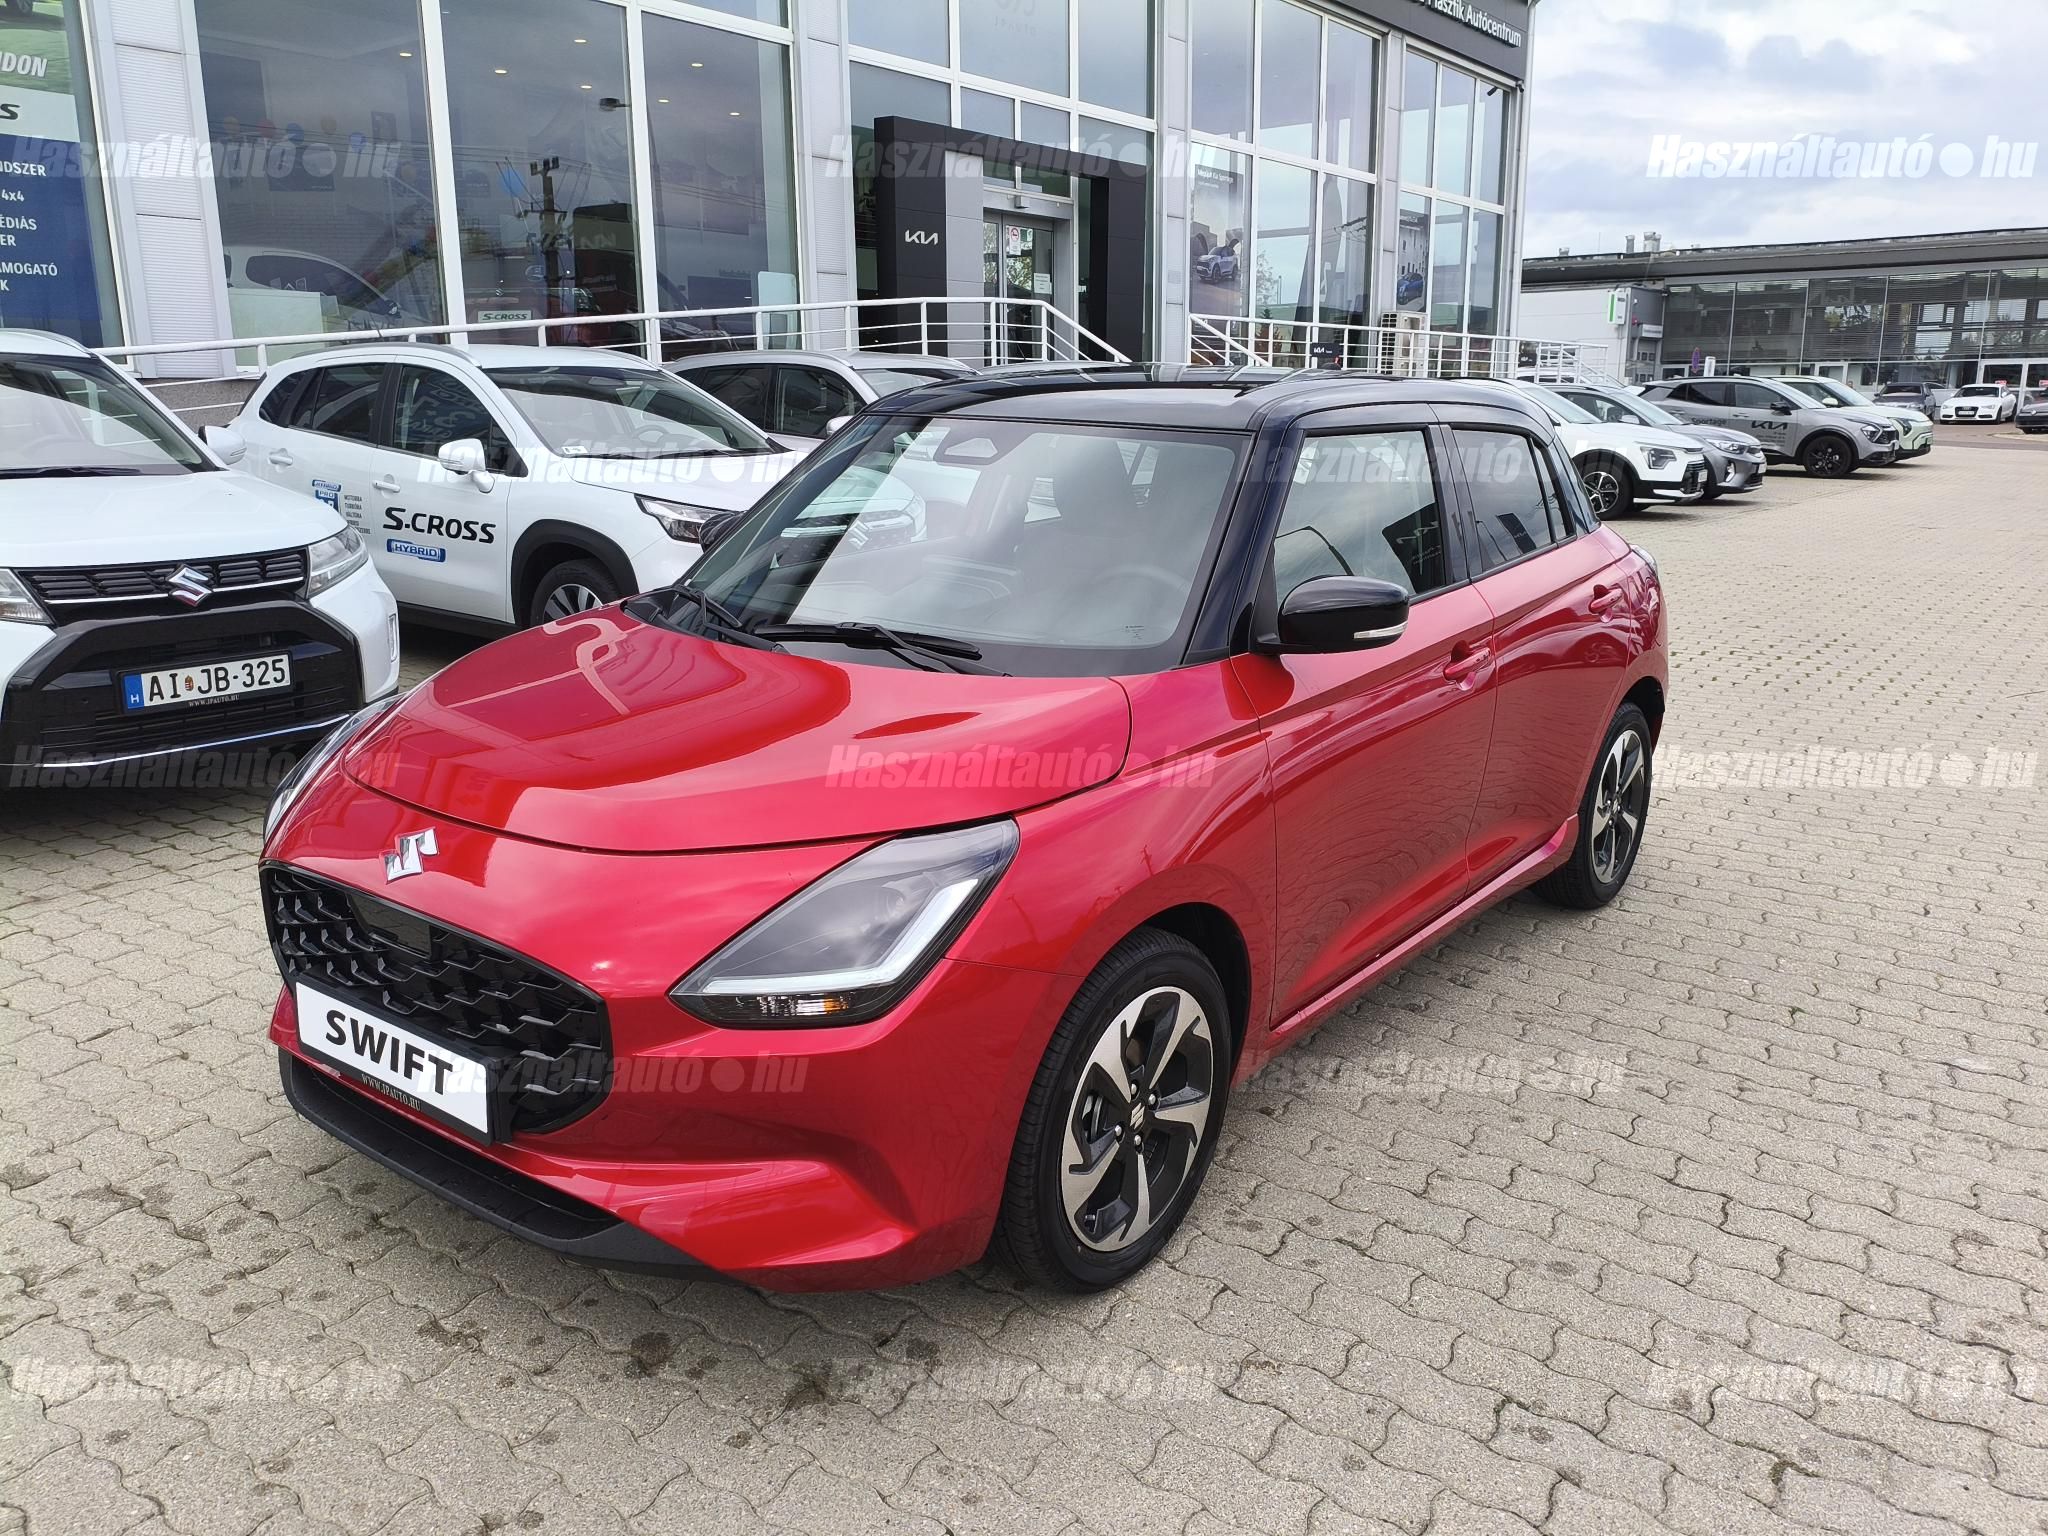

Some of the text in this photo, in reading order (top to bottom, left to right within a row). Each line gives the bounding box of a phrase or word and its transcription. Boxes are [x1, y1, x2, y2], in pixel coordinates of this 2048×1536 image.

[1466, 4, 1521, 47] Autócentrum
[0, 51, 48, 77] DON
[1, 189, 24, 202] 4x4
[905, 229, 939, 245] KIA
[1751, 420, 1788, 430] KIA
[319, 490, 334, 498] PRO
[394, 543, 438, 558] HYBRID
[149, 658, 286, 702] AI JB-325
[130, 694, 139, 704] H
[325, 1009, 453, 1096] SWIFT
[361, 1073, 422, 1112] WWW.JPAUTO.HU
